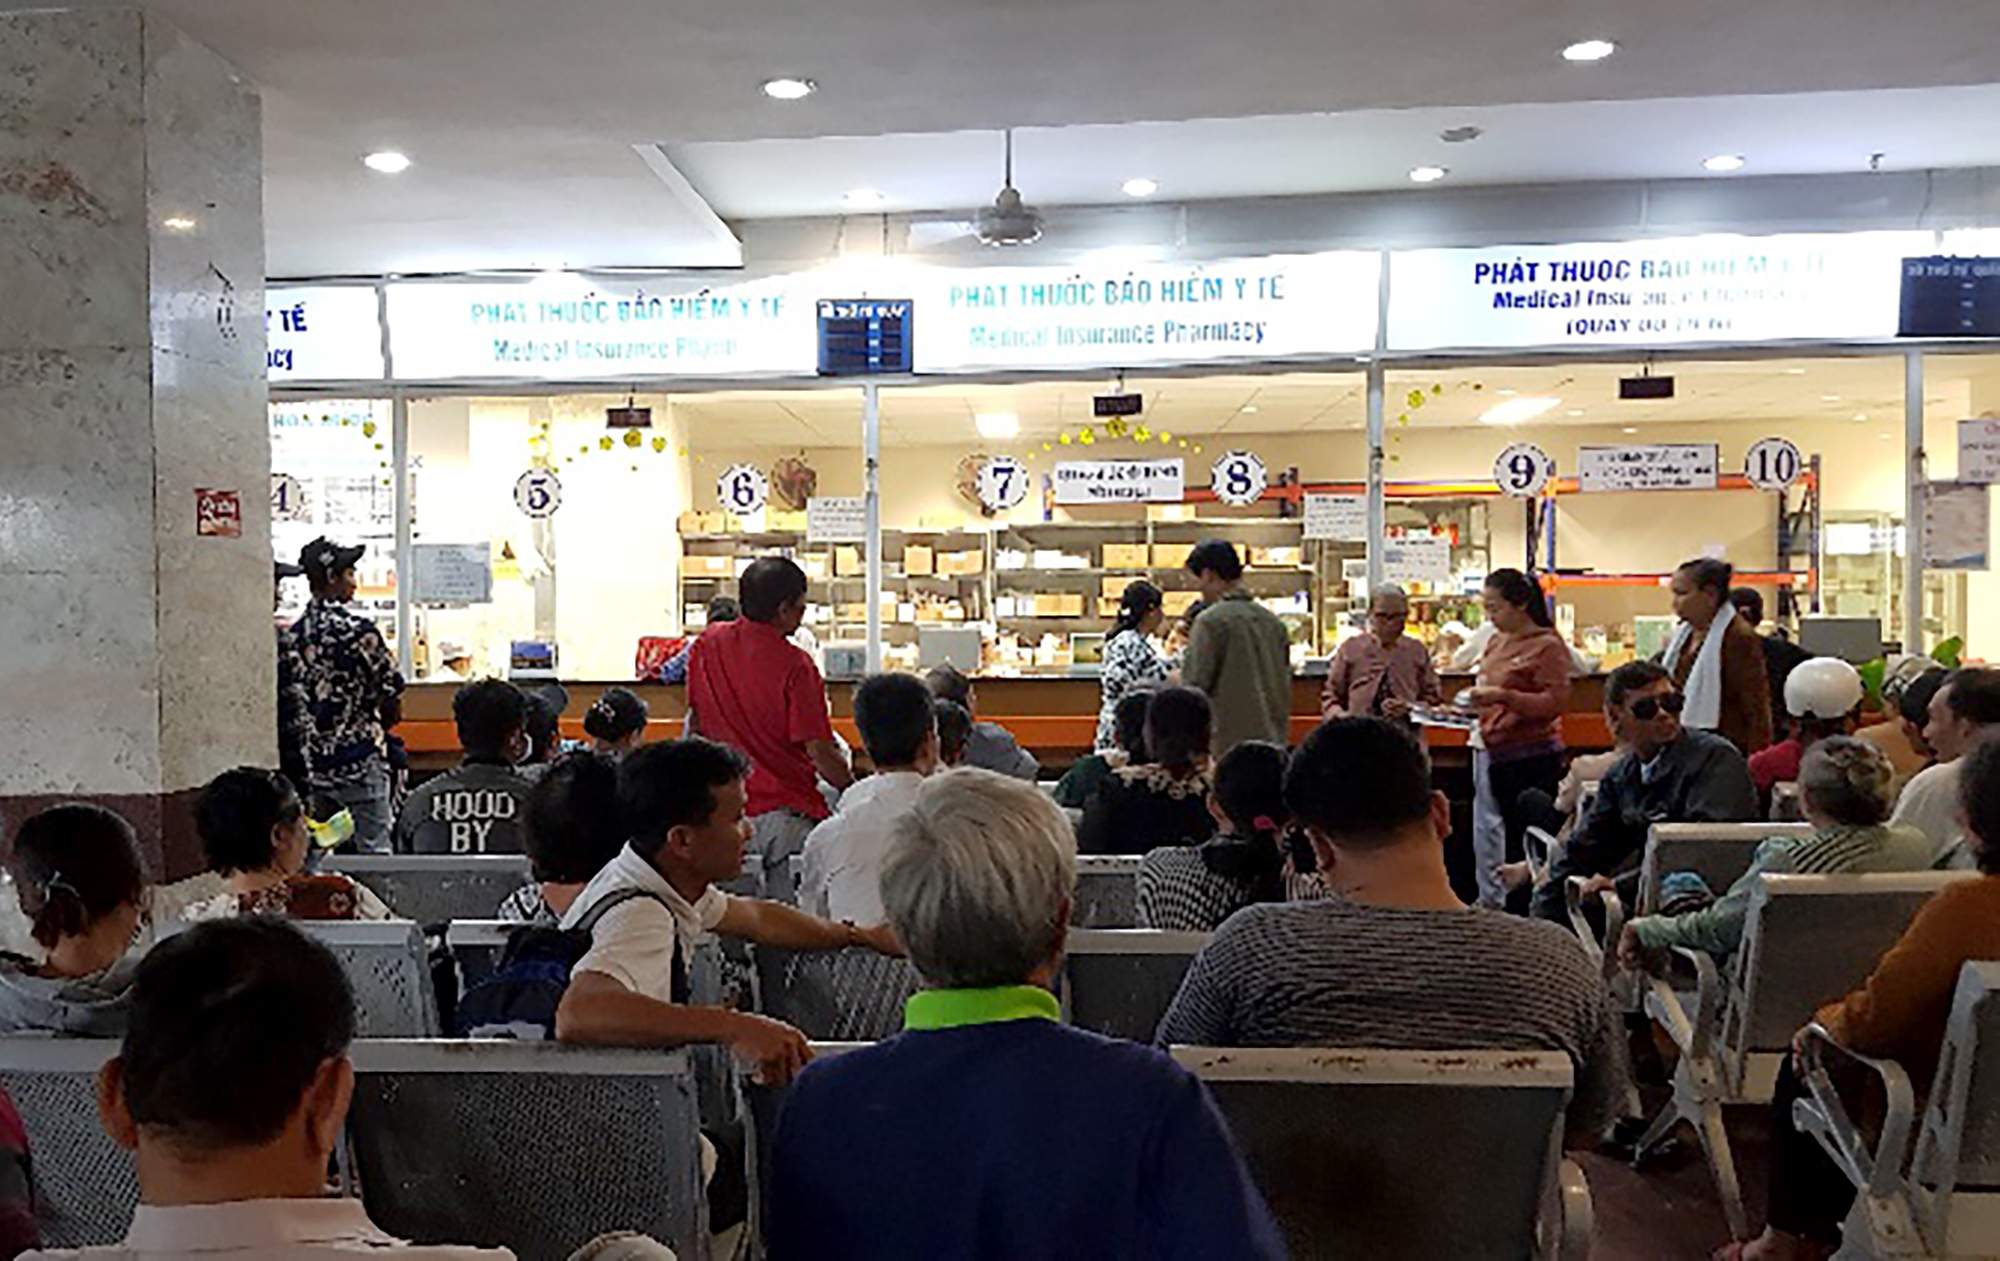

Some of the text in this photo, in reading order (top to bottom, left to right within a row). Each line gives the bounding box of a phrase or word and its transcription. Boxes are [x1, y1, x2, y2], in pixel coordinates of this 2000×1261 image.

[1235, 277, 1246, 300] Y
[1493, 290, 1581, 309] Medical
[1226, 460, 1252, 496] 8
[1508, 454, 1536, 488] 9
[1754, 447, 1795, 484] 10
[527, 478, 550, 510] 5
[732, 472, 754, 507] 6
[992, 466, 1015, 500] 7
[432, 790, 515, 821] HOOD
[451, 820, 494, 853] BY
